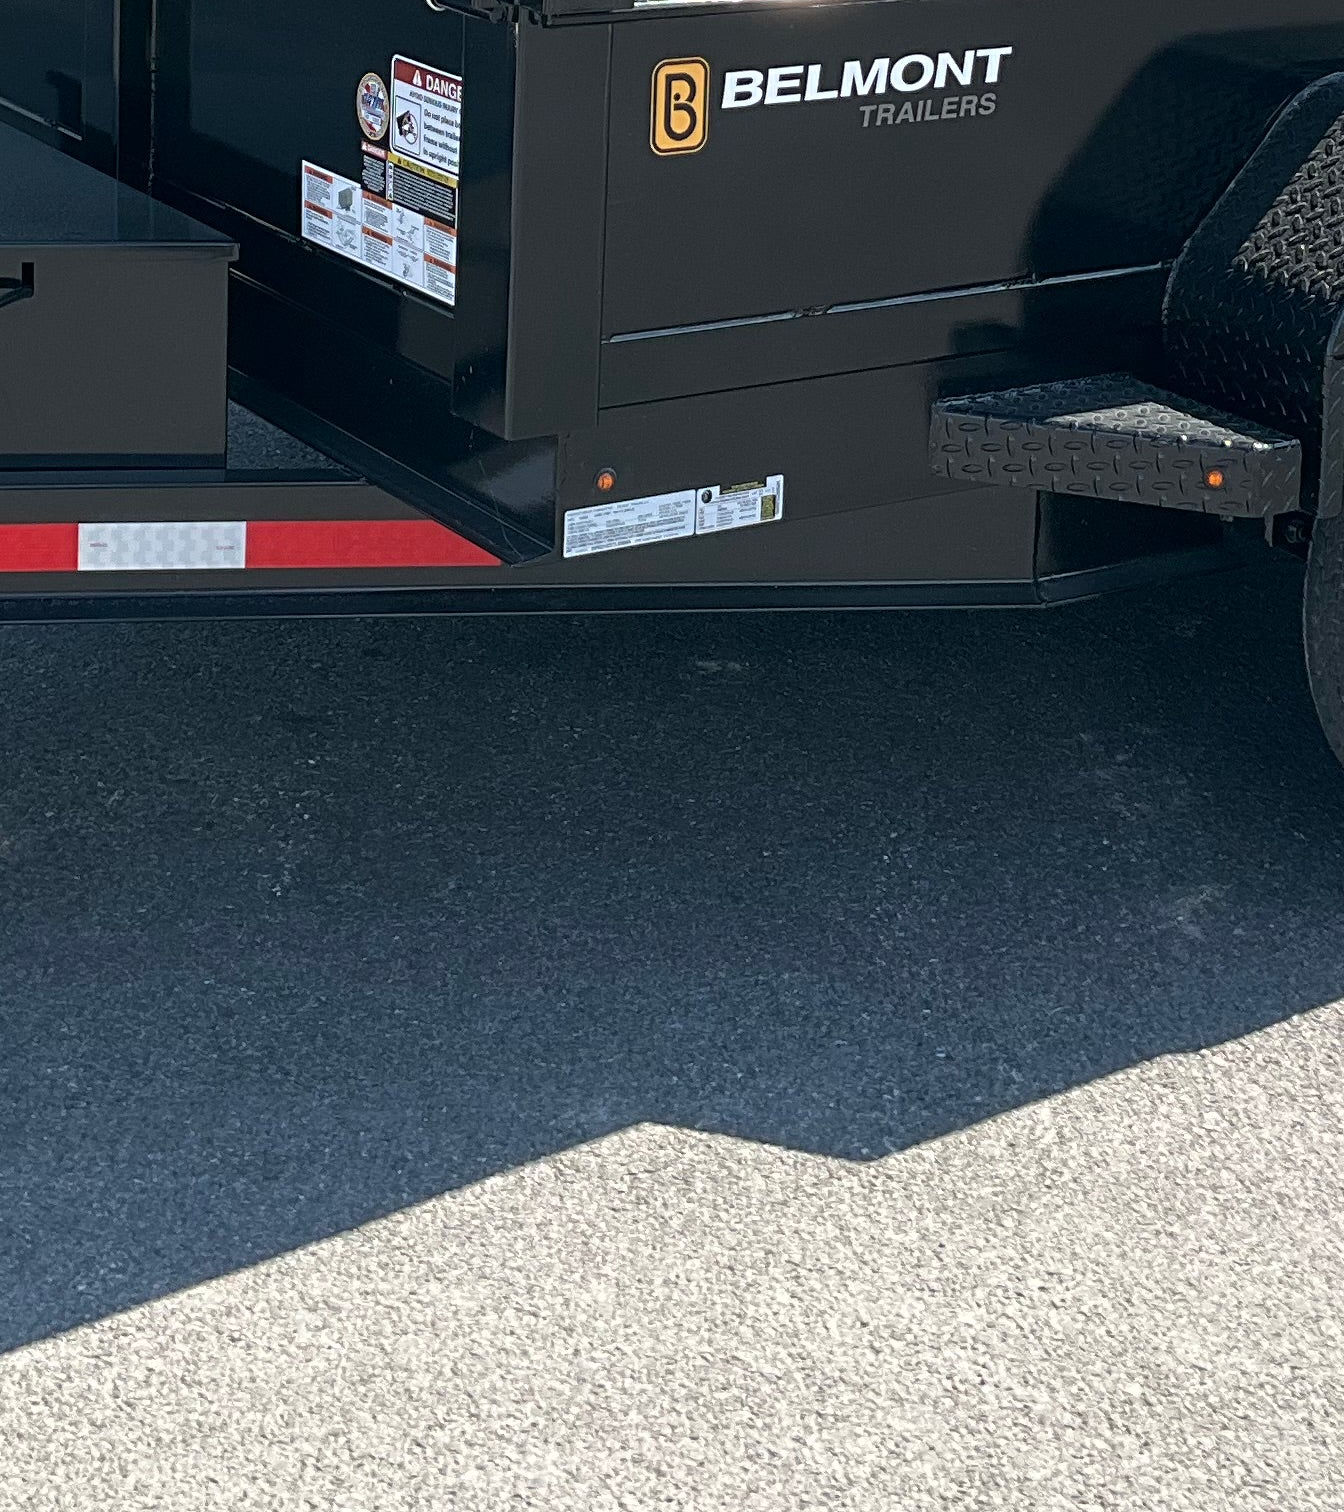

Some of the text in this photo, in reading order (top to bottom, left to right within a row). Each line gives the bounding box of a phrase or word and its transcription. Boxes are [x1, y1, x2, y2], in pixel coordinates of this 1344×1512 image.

[425, 74, 462, 102] DANGE
[721, 45, 1013, 109] BELMONT
[859, 92, 997, 128] TRAILERS
